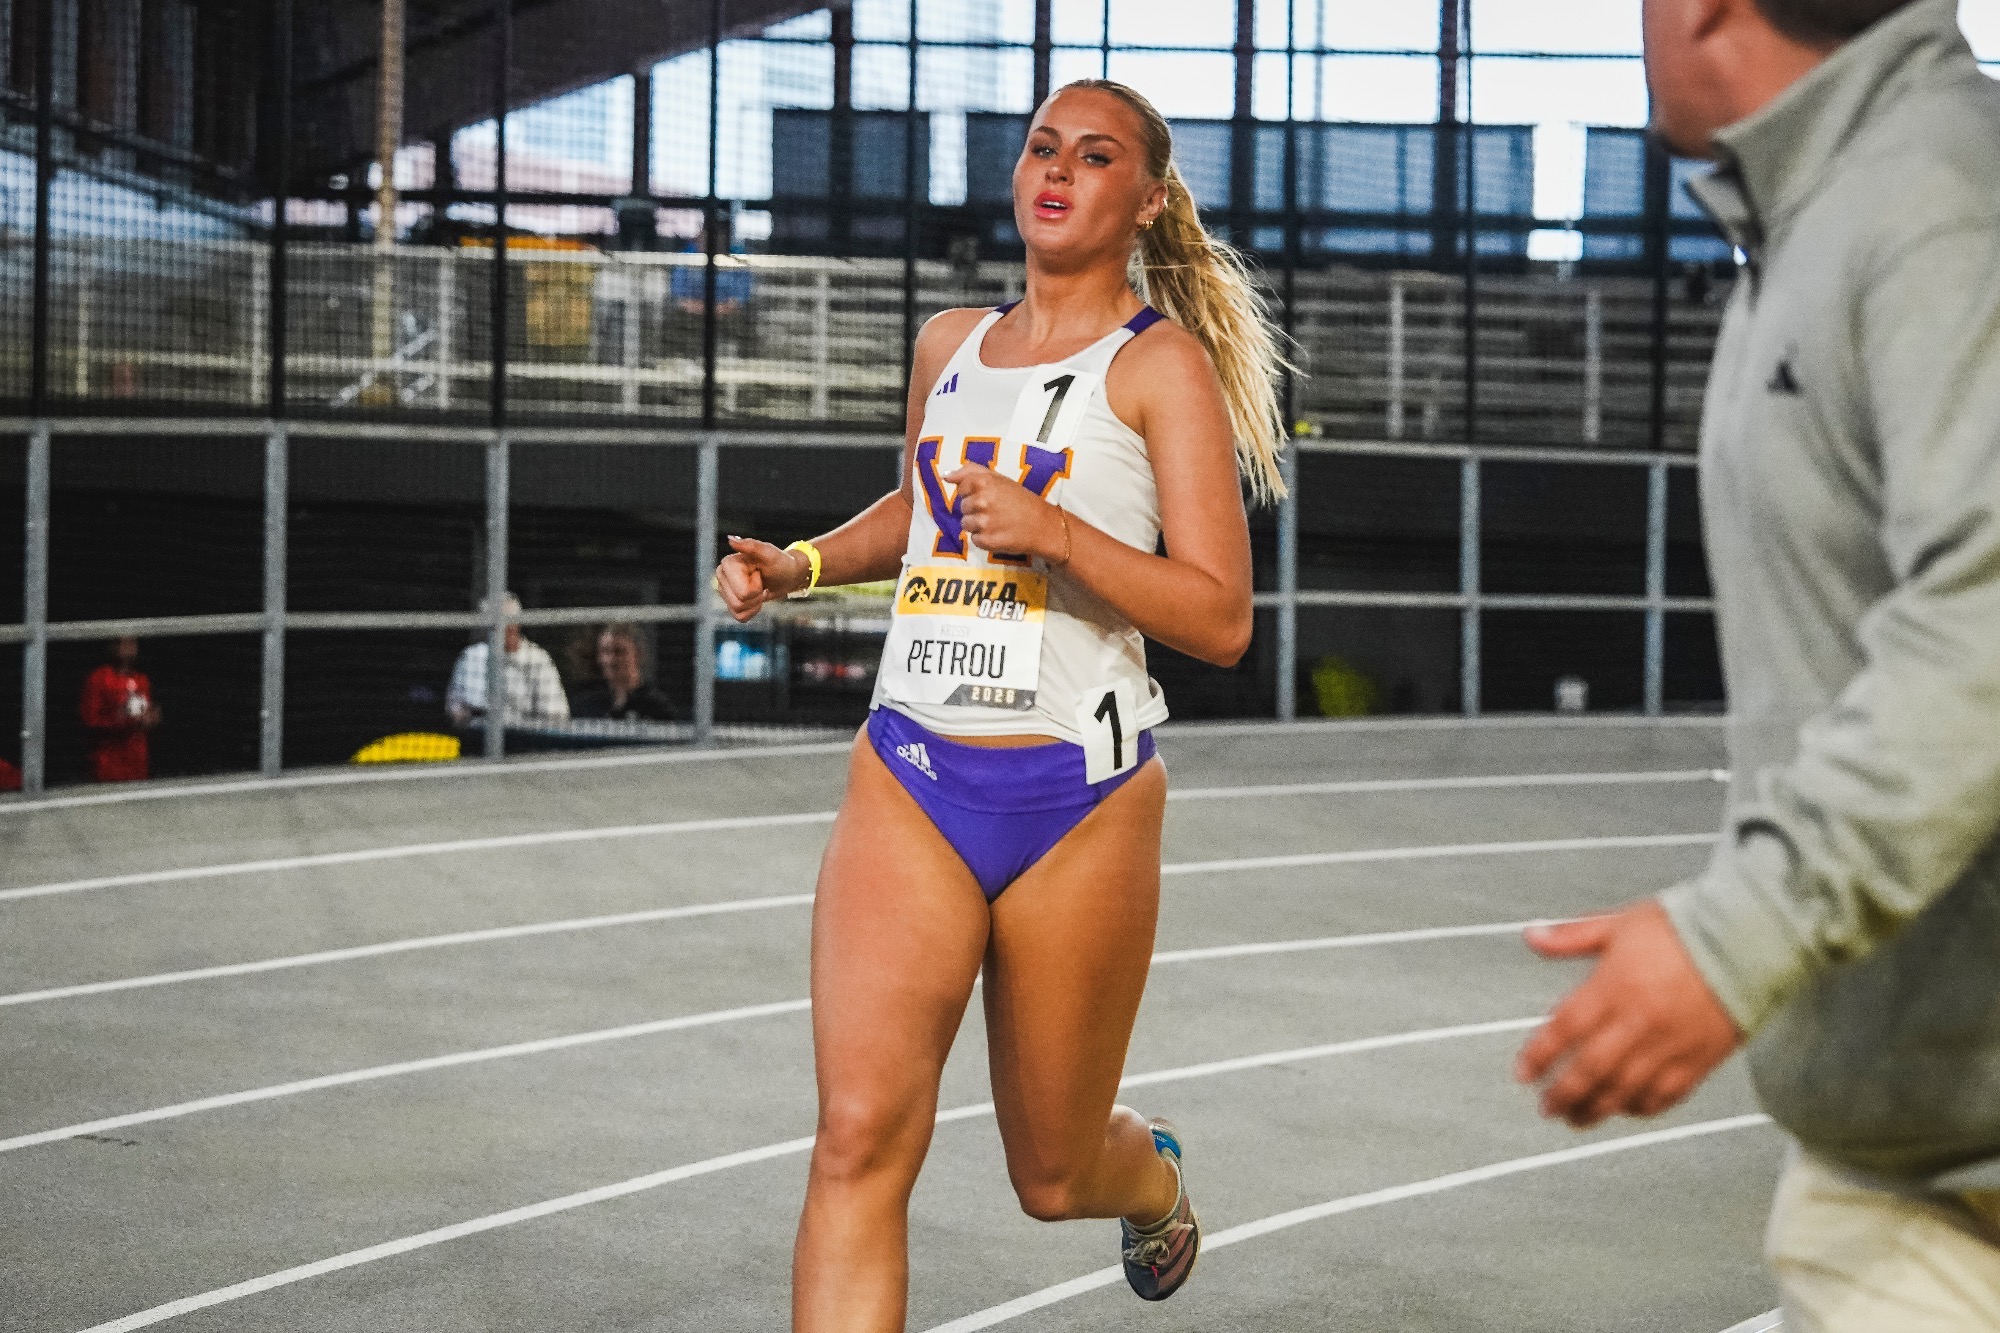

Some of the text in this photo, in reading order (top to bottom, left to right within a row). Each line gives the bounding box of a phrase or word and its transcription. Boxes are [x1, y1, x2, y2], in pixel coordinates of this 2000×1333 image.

[1037, 374, 1076, 443] 1
[930, 578, 1018, 605] IOWA
[978, 599, 1026, 621] OPEN
[907, 639, 1006, 679] PETROU
[1094, 690, 1123, 771] 1
[896, 745, 937, 781] adidas
